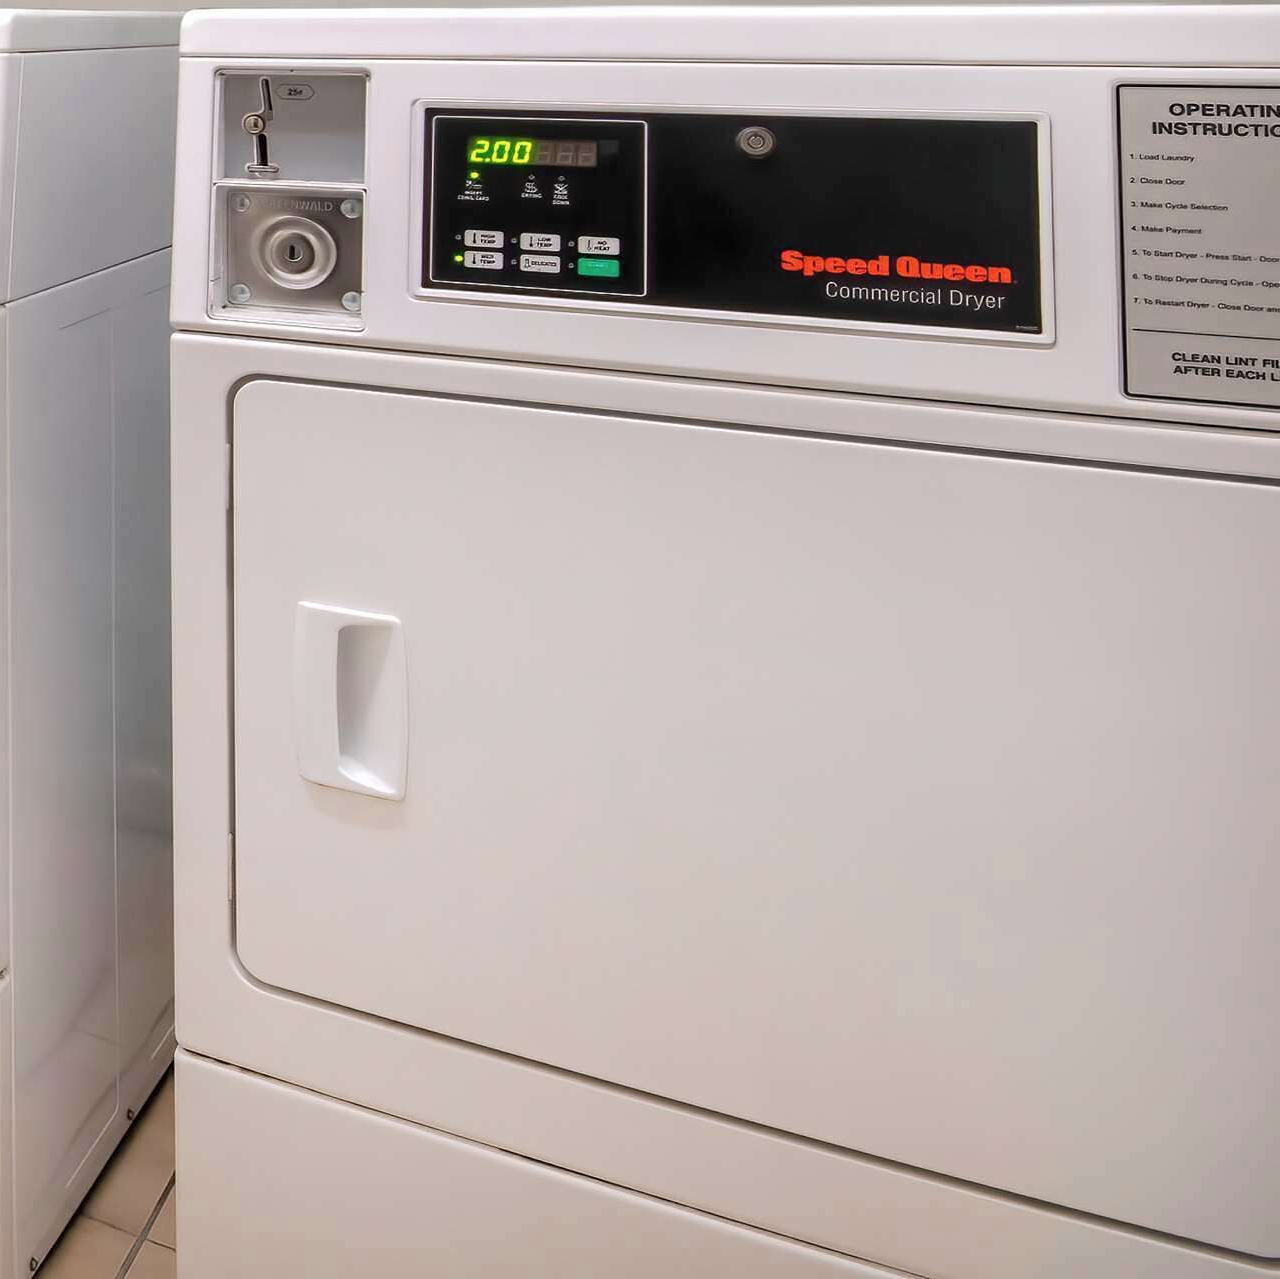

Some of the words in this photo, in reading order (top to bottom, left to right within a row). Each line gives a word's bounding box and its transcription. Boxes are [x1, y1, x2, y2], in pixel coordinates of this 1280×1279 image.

[470, 139, 533, 163] 2.00
[1139, 153, 1160, 161] Load
[1162, 154, 1195, 163] Laundry
[1140, 177, 1163, 185] Close
[1165, 178, 1185, 186] Door
[1140, 201, 1163, 209] Make
[1165, 202, 1188, 211] Cycle
[1190, 203, 1229, 211] Selection
[1141, 225, 1164, 233] Make
[1166, 226, 1202, 235] Payment
[1142, 249, 1152, 257] To
[1154, 250, 1173, 258] Start
[1175, 251, 1198, 259] Dryer
[1205, 252, 1229, 260] Press
[1232, 254, 1252, 262] Start
[780, 250, 890, 276] Speed
[896, 256, 1012, 284] Queen
[1143, 273, 1152, 281] To
[1155, 274, 1174, 283] Stop
[1175, 275, 1198, 284] Dryer
[1200, 277, 1228, 286] During
[1230, 279, 1254, 288] Cycle
[825, 282, 942, 305] Commercial
[949, 289, 1006, 311] Dryer
[1155, 298, 1185, 307] Restart
[1187, 300, 1210, 309] Dryer
[1217, 302, 1242, 311] Close
[1244, 304, 1264, 312] Door
[1172, 352, 1221, 364] CLEAN
[1225, 356, 1258, 367] LINT
[1173, 365, 1221, 377] AFTER
[1225, 368, 1266, 381] EACH
